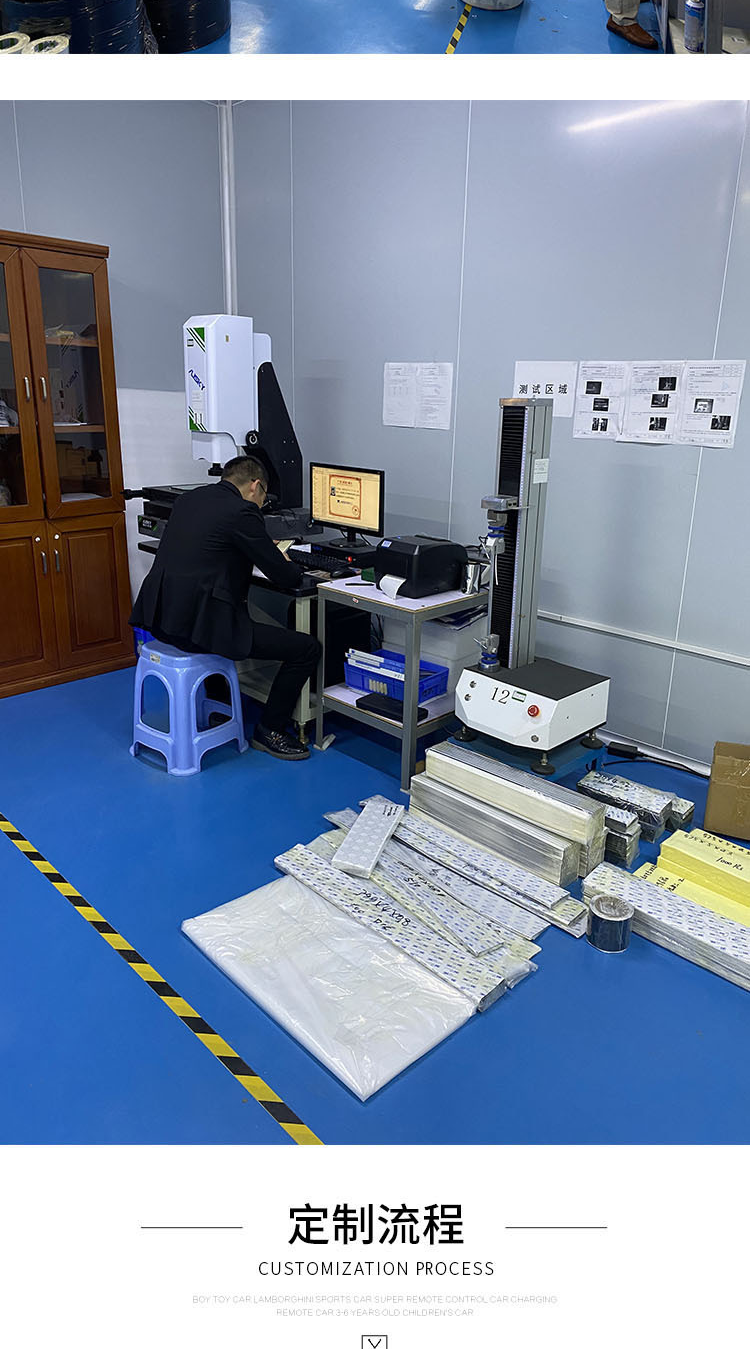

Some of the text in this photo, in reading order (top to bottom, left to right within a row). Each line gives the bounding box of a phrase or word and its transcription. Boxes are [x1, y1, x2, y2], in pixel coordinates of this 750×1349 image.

[518, 383, 569, 395] 测试区域
[491, 686, 511, 705] 12
